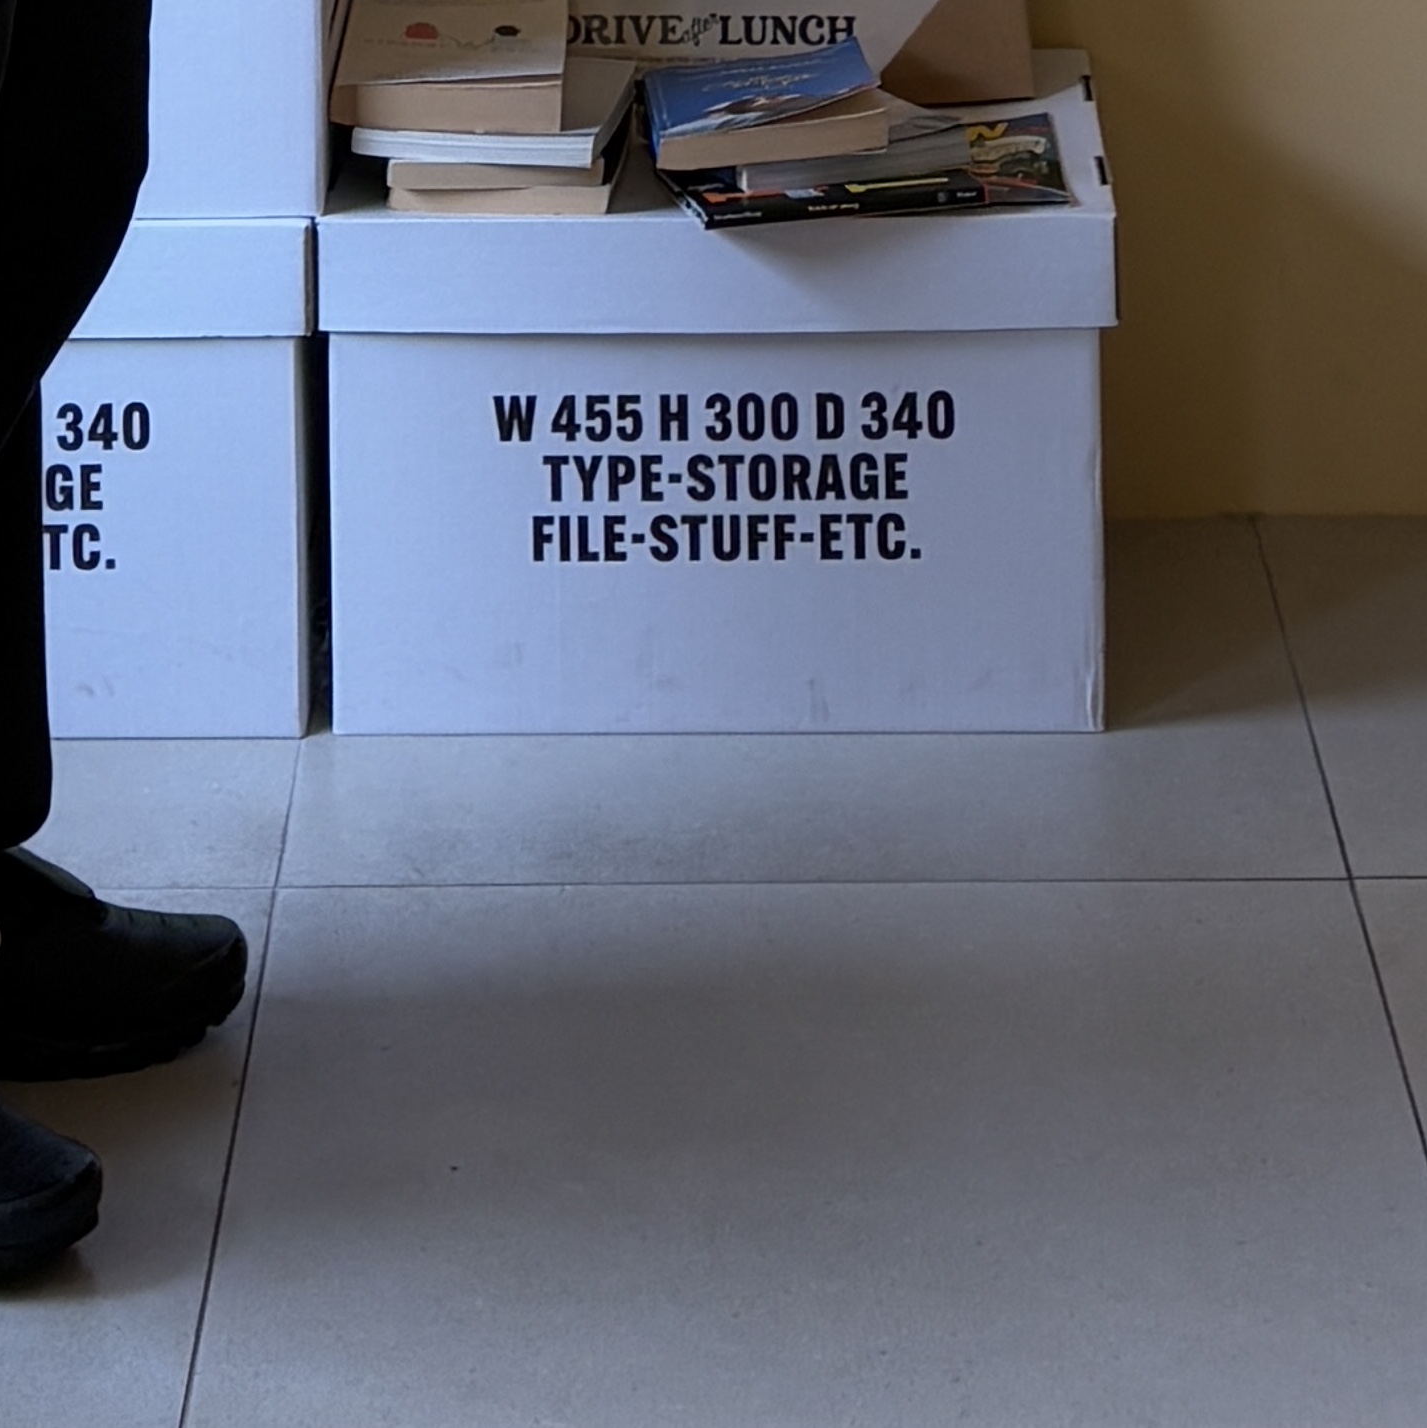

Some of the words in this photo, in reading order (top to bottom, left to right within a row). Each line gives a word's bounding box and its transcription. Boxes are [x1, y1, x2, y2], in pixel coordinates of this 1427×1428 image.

[720, 15, 856, 44] LUNCH
[56, 402, 151, 451] 340
[492, 395, 537, 442] W
[551, 393, 644, 442] 455
[660, 393, 688, 440] H
[704, 392, 800, 441] 300
[817, 392, 844, 439] D
[861, 390, 955, 439] 340
[542, 453, 909, 502] TYPE-STORAGE
[531, 513, 922, 562] FILE-STUFF-ETC.
